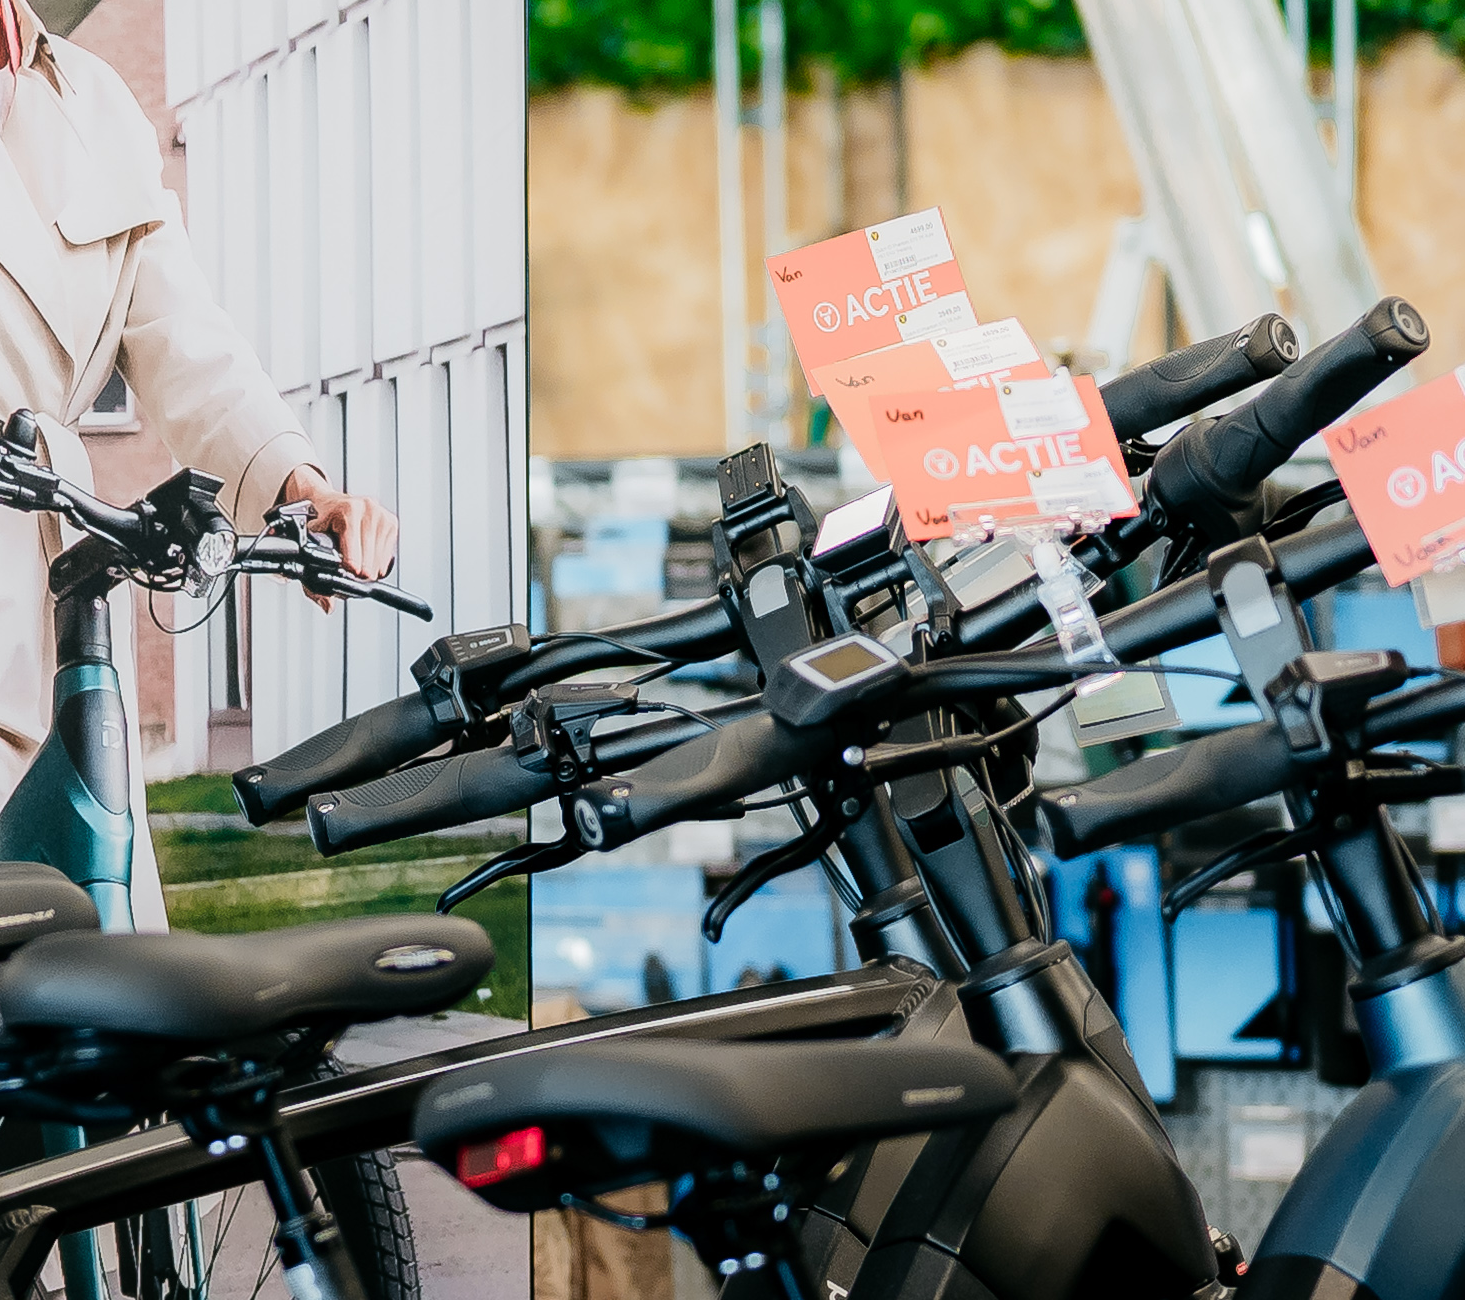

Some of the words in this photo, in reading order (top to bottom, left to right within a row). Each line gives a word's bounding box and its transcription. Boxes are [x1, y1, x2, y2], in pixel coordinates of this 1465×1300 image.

[775, 267, 803, 283] Van
[847, 271, 938, 326] ACTIE
[886, 408, 924, 423] Van
[966, 432, 1088, 477] ACTIE
[1336, 424, 1387, 455] Van
